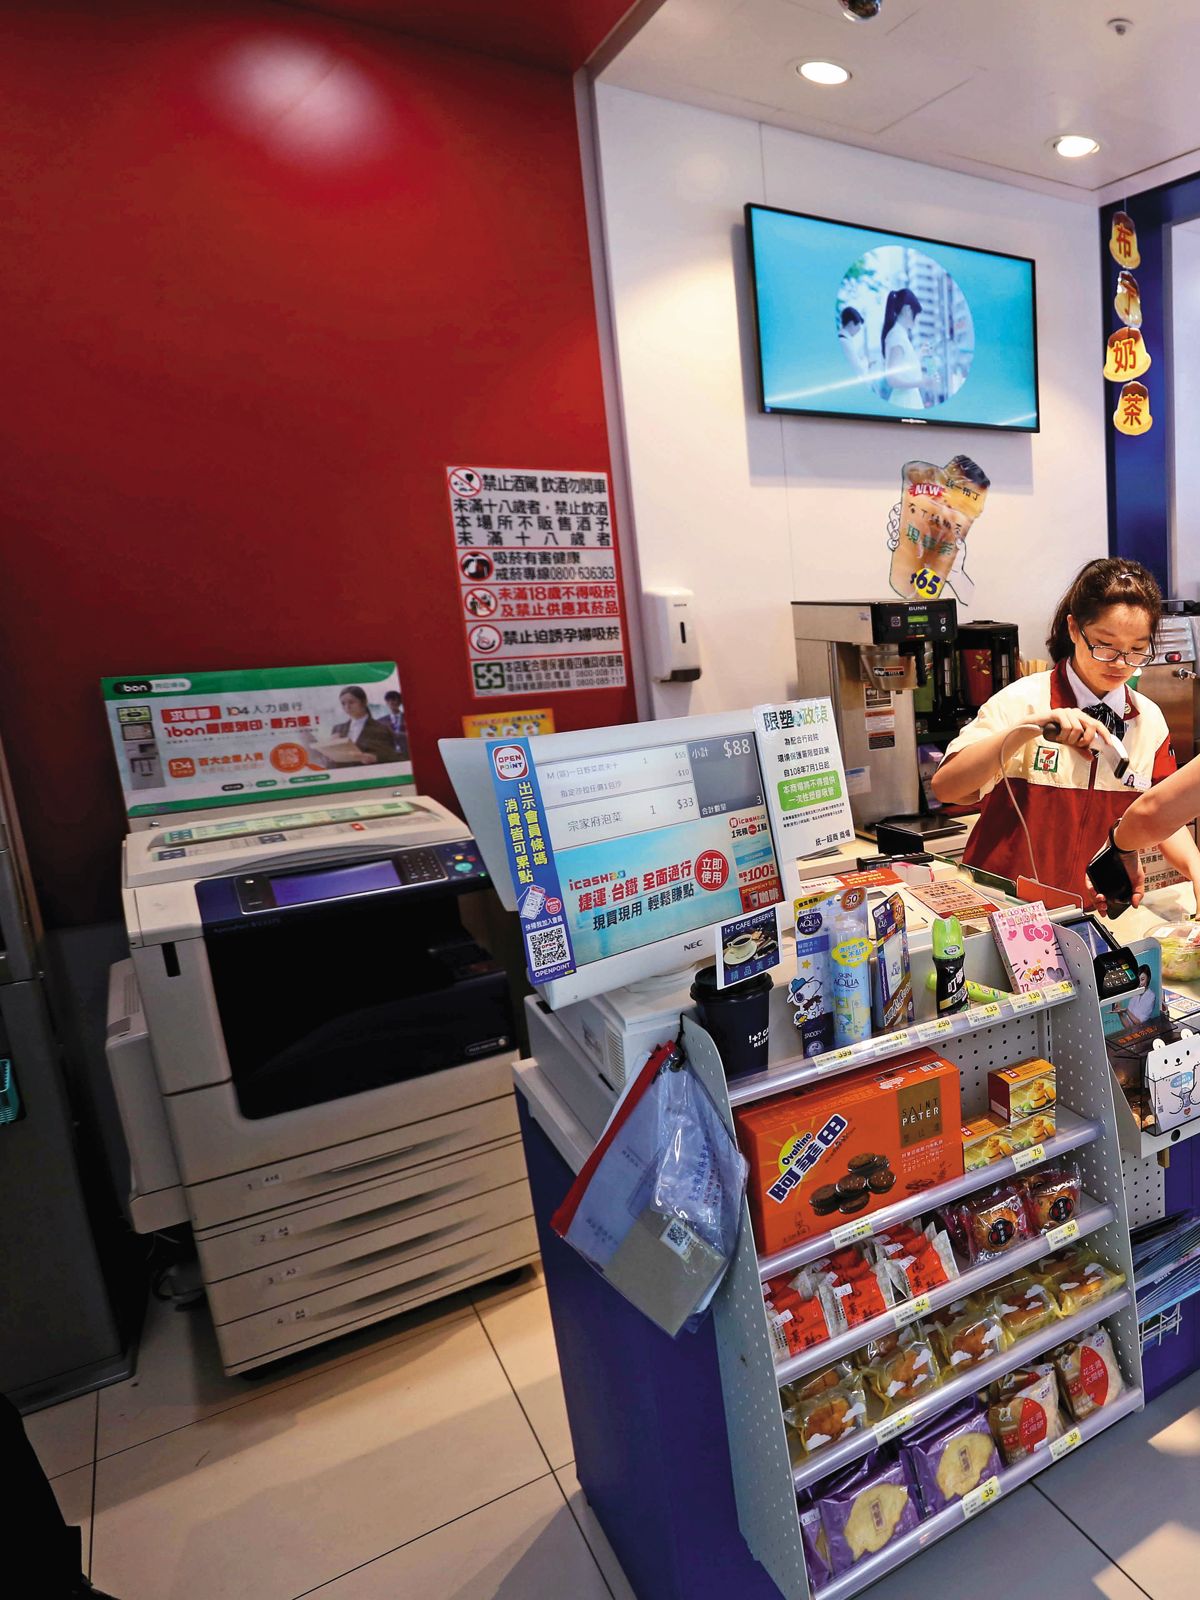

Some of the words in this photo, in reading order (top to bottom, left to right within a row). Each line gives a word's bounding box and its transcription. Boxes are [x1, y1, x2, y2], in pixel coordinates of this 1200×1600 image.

[483, 474, 538, 493] 禁止酒駕
[541, 477, 606, 494] 飲酒勿開車
[455, 516, 609, 531] 本場所不販售酒予
[457, 531, 611, 546] 未滿十八歲者
[493, 552, 580, 565] 吸菸有害健康
[499, 586, 616, 601] 未滿18歲不得吸菸
[501, 601, 618, 617] 及禁止供應其菸品
[724, 738, 751, 758] $88
[498, 755, 521, 763] OPEN
[757, 796, 762, 804] 3
[568, 811, 623, 832] 宗家府泡菜
[677, 798, 694, 810] $33
[518, 781, 548, 866] 出示會員條碼
[504, 798, 534, 884] 消費皆可累點
[701, 857, 723, 871] 立即
[642, 859, 692, 890] 全面通行
[701, 870, 723, 884] 使用
[593, 903, 643, 930] 現買現用
[735, 920, 751, 930] CAFE
[752, 910, 774, 925] RESERVE
[799, 918, 821, 927] AQUA
[683, 939, 703, 951] NEC
[534, 962, 571, 978] OPENPOINT
[833, 978, 860, 989] AQUA
[985, 1004, 998, 1013] 135
[937, 1019, 950, 1028] 250
[838, 1050, 852, 1058] 399
[902, 1097, 938, 1116] SAINT
[902, 1106, 939, 1126] PETER
[781, 1132, 813, 1166] Ovaltine
[767, 1114, 848, 1204] 阿華田
[1067, 1224, 1076, 1232] 59
[1069, 1432, 1078, 1442] 39
[984, 1487, 994, 1497] 35
